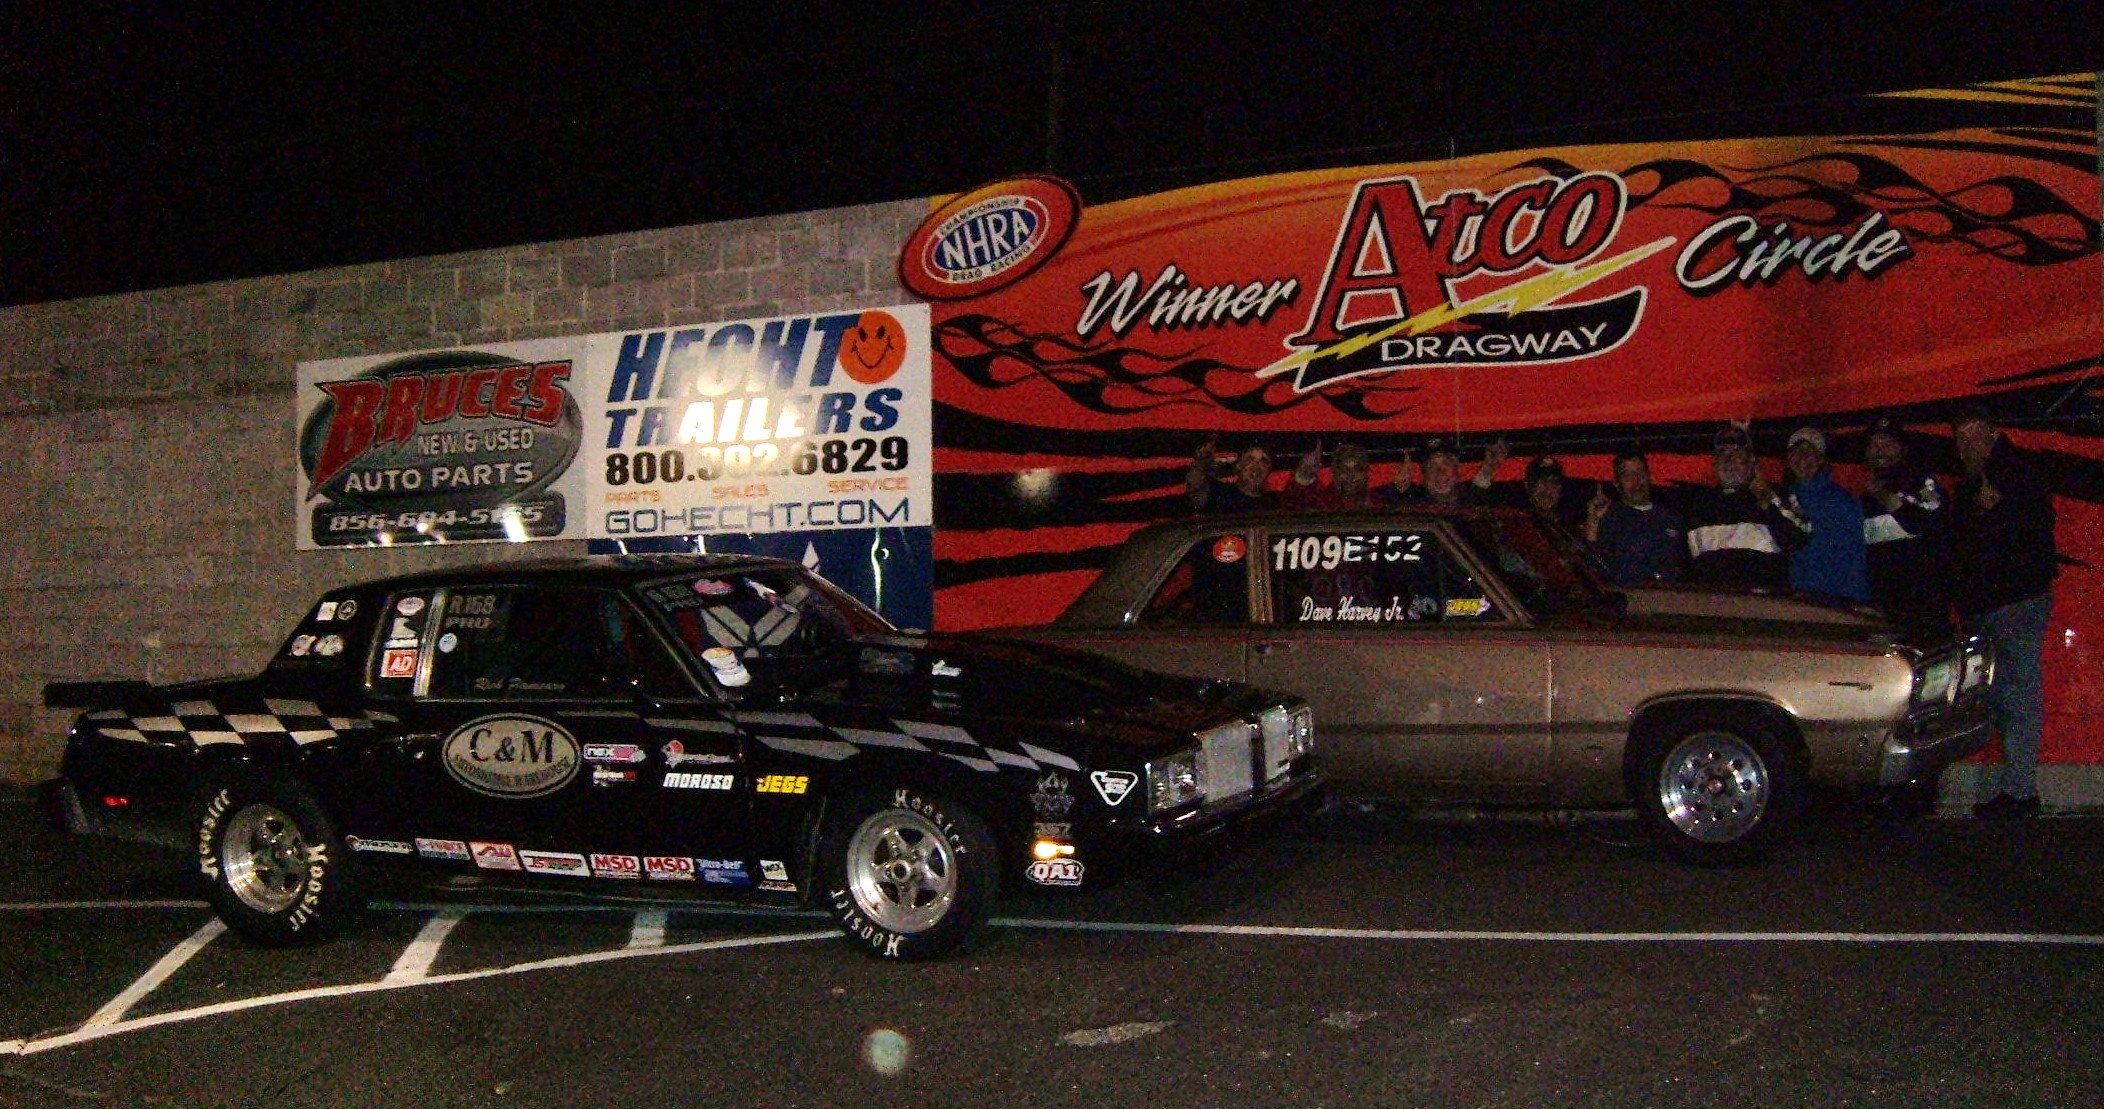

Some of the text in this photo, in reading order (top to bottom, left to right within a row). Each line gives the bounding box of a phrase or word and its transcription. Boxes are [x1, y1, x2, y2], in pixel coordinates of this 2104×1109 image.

[941, 210, 1031, 269] NHRA
[952, 242, 1032, 281] DRAG RACING
[1077, 171, 1909, 348] Winner Atco Circle
[1381, 322, 1609, 363] DRAGWAY
[607, 313, 861, 403] HECHT
[305, 359, 573, 502] BRUCES
[604, 387, 903, 448] TRAILERS
[417, 427, 535, 456] NEW & USED
[344, 461, 534, 493] AUTO PARTS
[604, 476, 909, 503] PARTS SALES SERVICE
[605, 497, 910, 534] GOHECHT.COM
[1299, 595, 1405, 623] Dave Harvey Jr.
[390, 655, 413, 673] AD
[662, 772, 735, 790] MOROSO
[756, 775, 809, 794] JEGS
[594, 856, 636, 871] MSD
[648, 857, 691, 872] MSD
[1033, 863, 1077, 881] QA1
